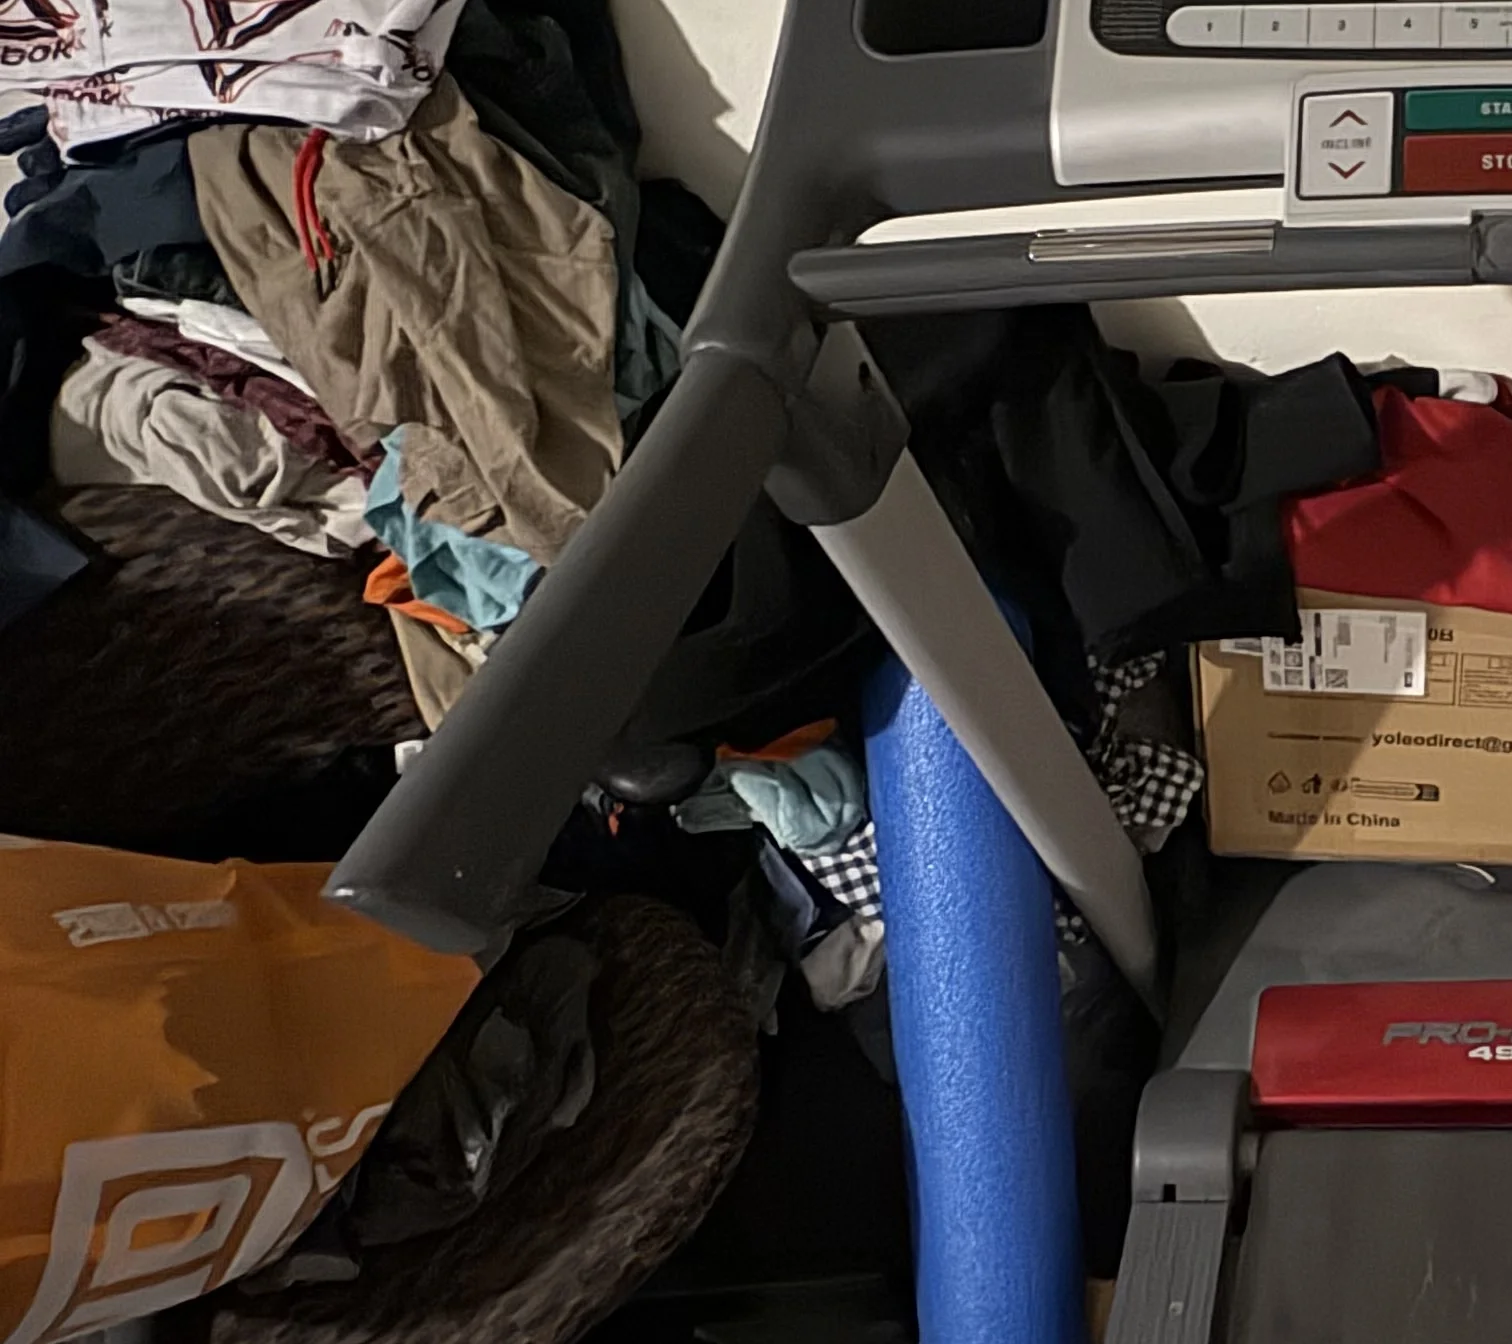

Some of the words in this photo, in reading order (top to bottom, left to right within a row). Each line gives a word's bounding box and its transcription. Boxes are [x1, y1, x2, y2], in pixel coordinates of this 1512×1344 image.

[1403, 17, 1412, 29] 4
[1470, 17, 1479, 29] 5
[1321, 136, 1372, 150] INCLINE
[1268, 809, 1318, 825] Made
[1324, 811, 1341, 825] in
[1347, 812, 1401, 828] China
